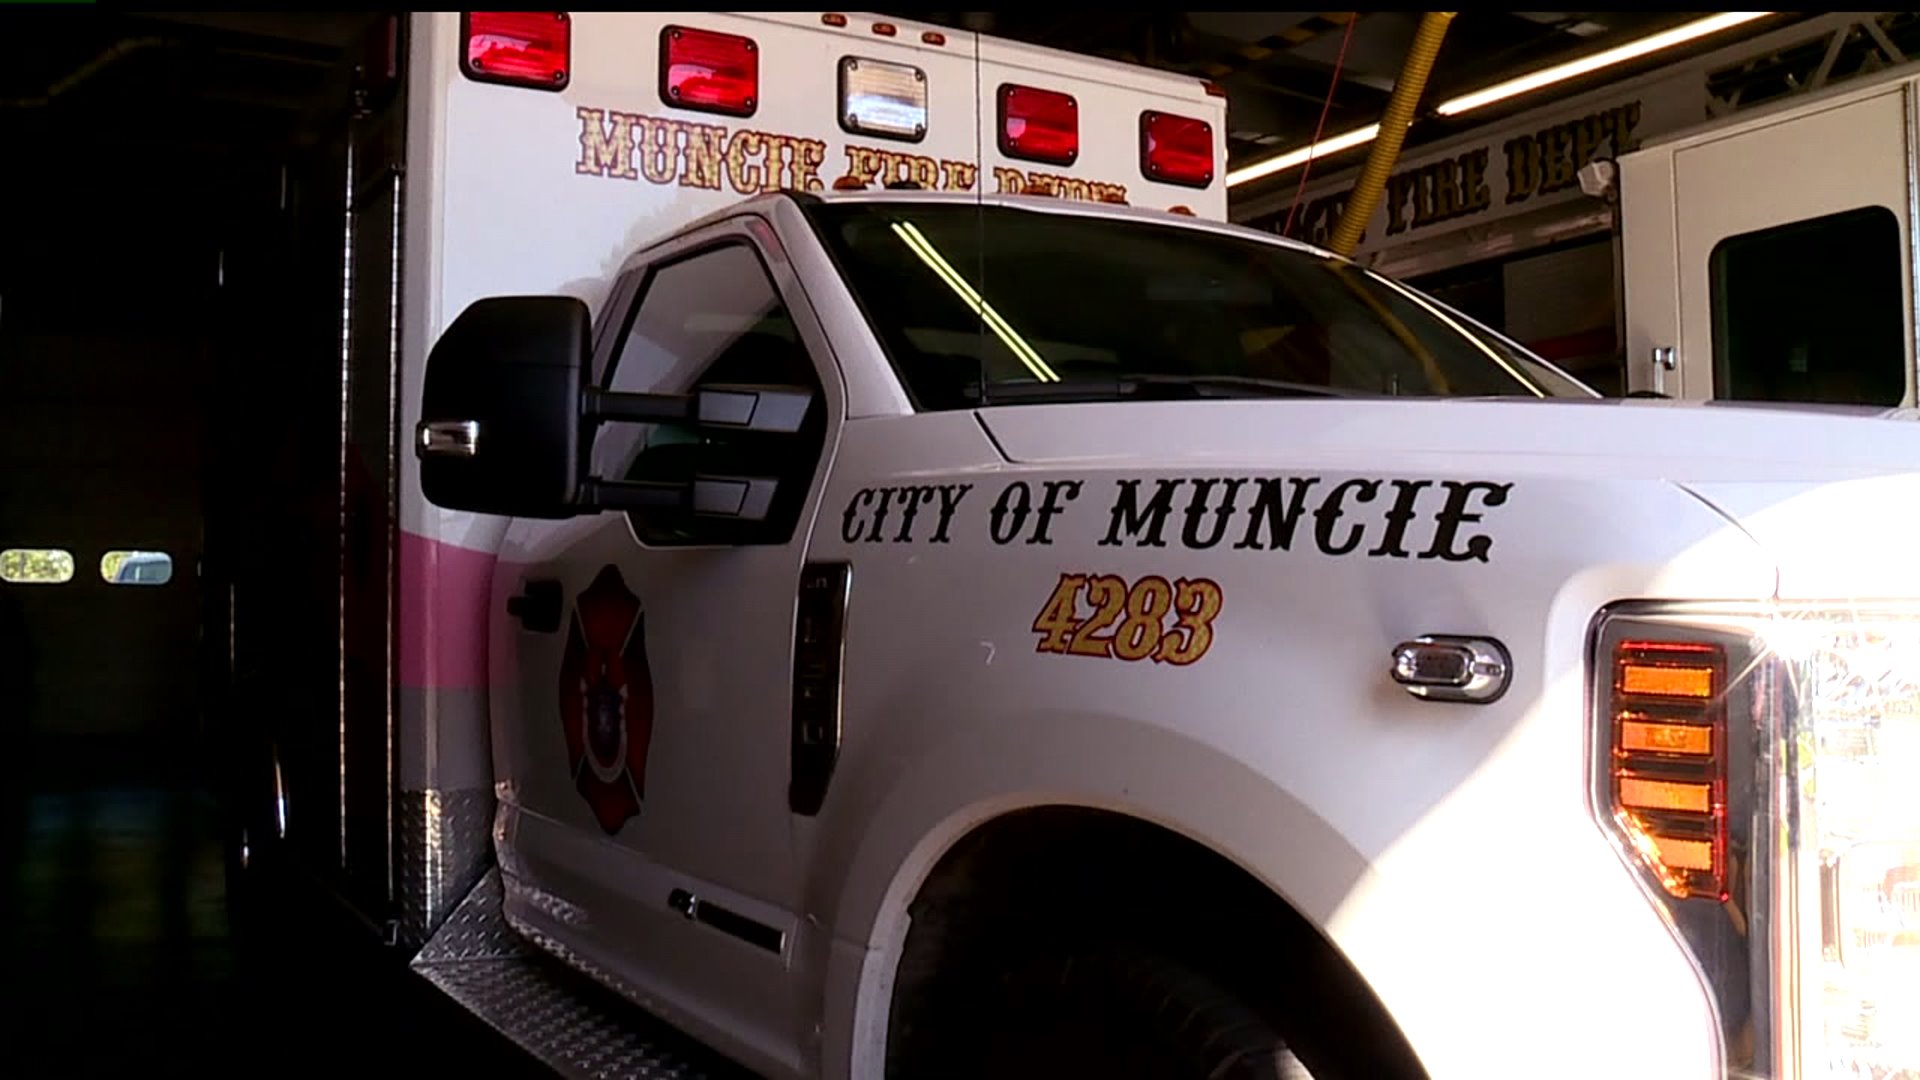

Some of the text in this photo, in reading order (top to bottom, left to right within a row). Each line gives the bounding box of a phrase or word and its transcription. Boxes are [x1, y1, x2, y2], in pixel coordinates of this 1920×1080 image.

[576, 107, 826, 195] MUNCIE
[844, 145, 978, 191] FIRE
[1386, 147, 1490, 236] FIRE
[841, 476, 1515, 563] CITY OF MUNCIE
[1032, 572, 1223, 667] 4283
